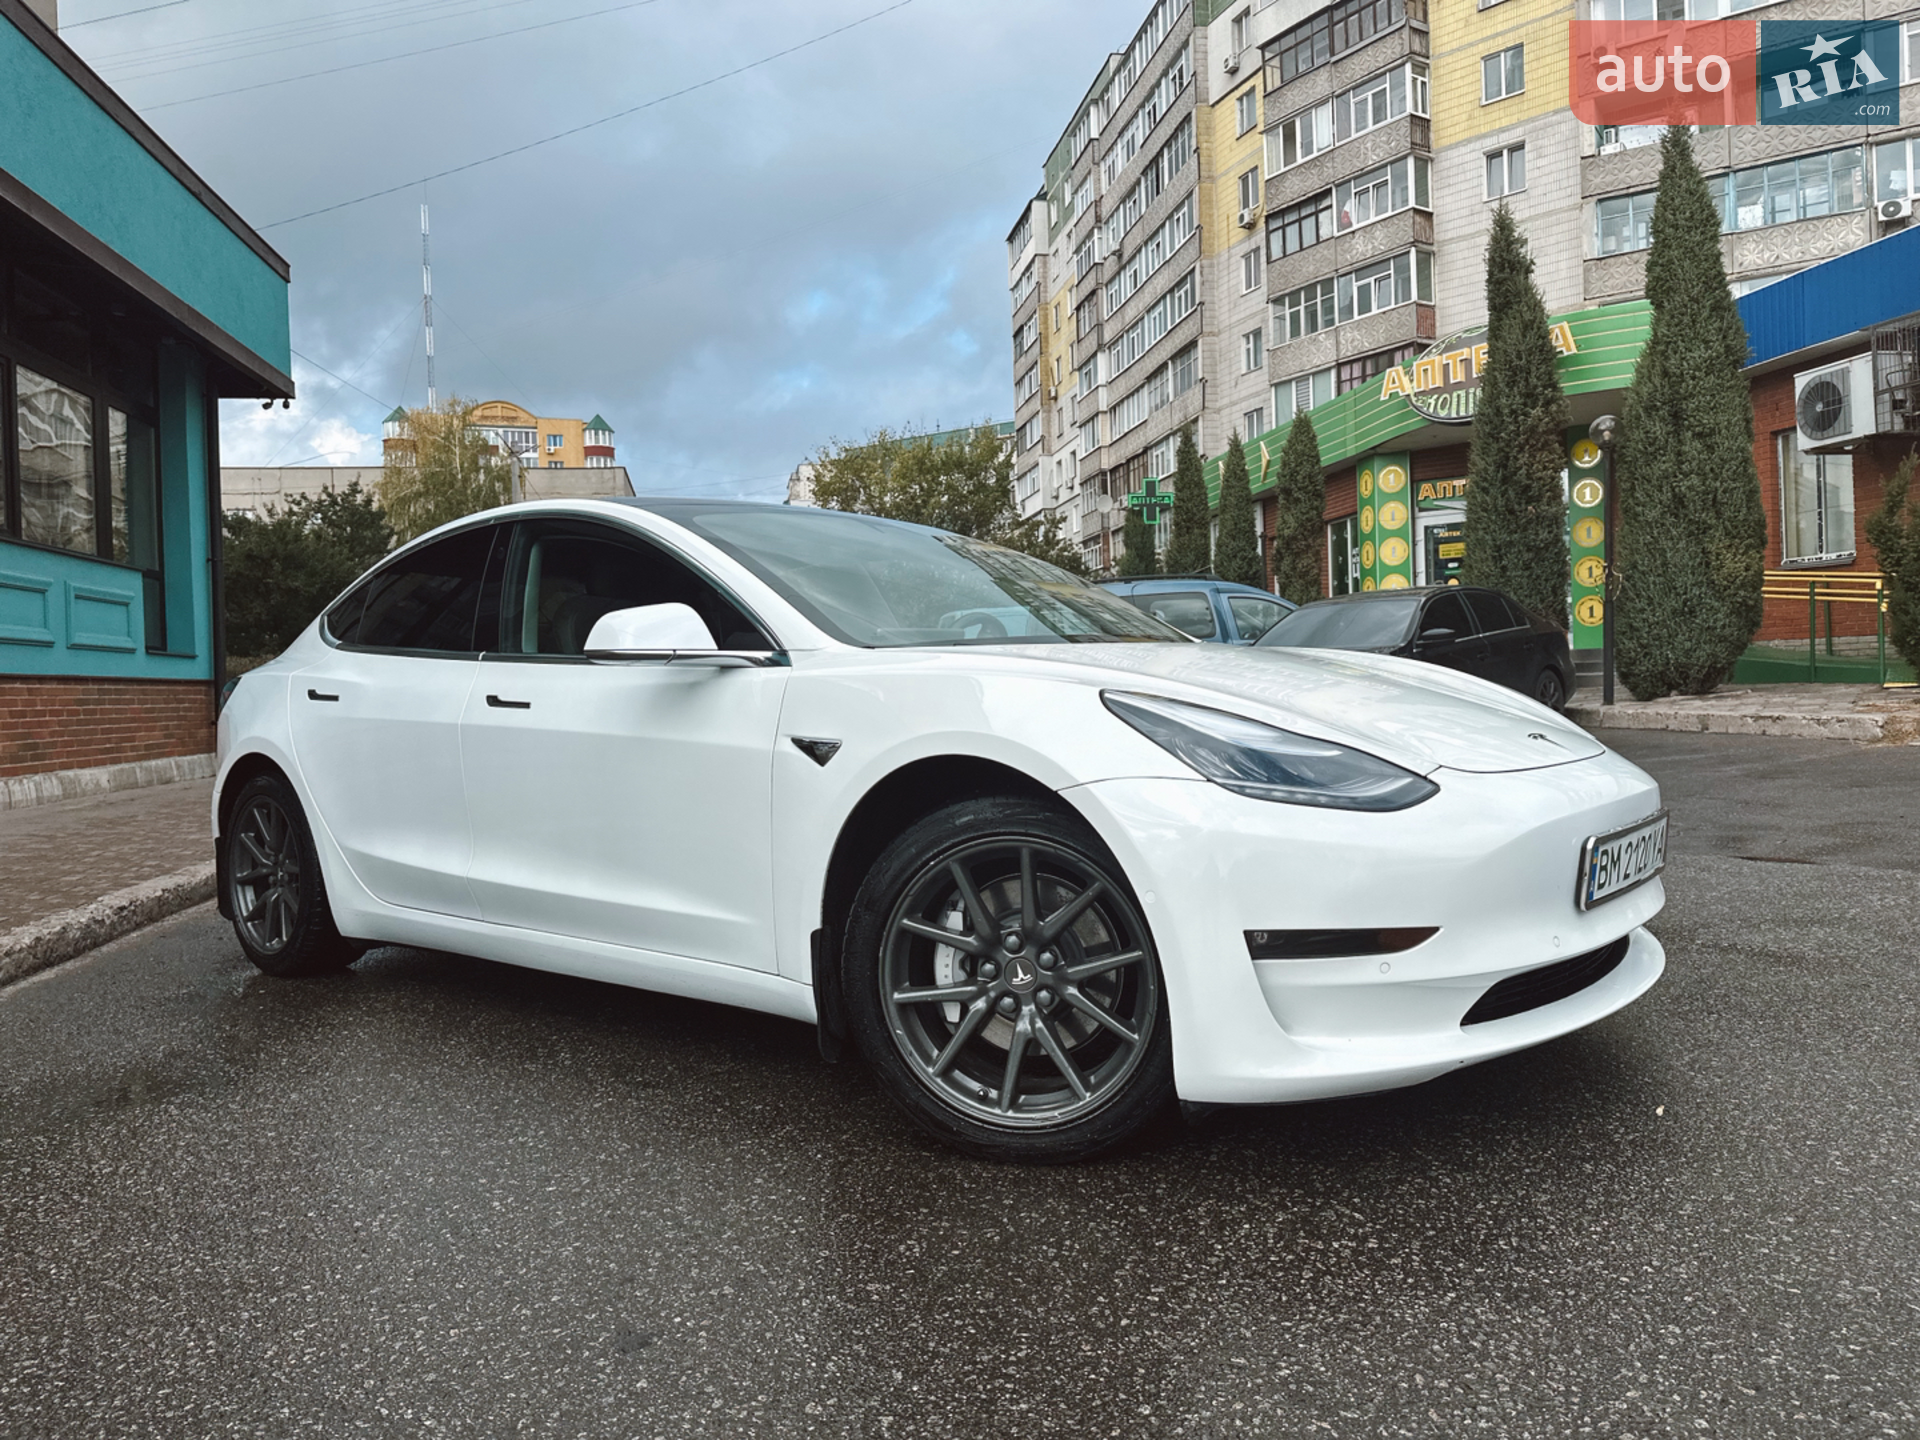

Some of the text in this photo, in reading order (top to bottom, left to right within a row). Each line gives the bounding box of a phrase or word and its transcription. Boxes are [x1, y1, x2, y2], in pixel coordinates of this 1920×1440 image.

[1380, 321, 1577, 401] АПТЕА
[1418, 478, 1469, 500] АПТ
[1597, 843, 1622, 890] BM
